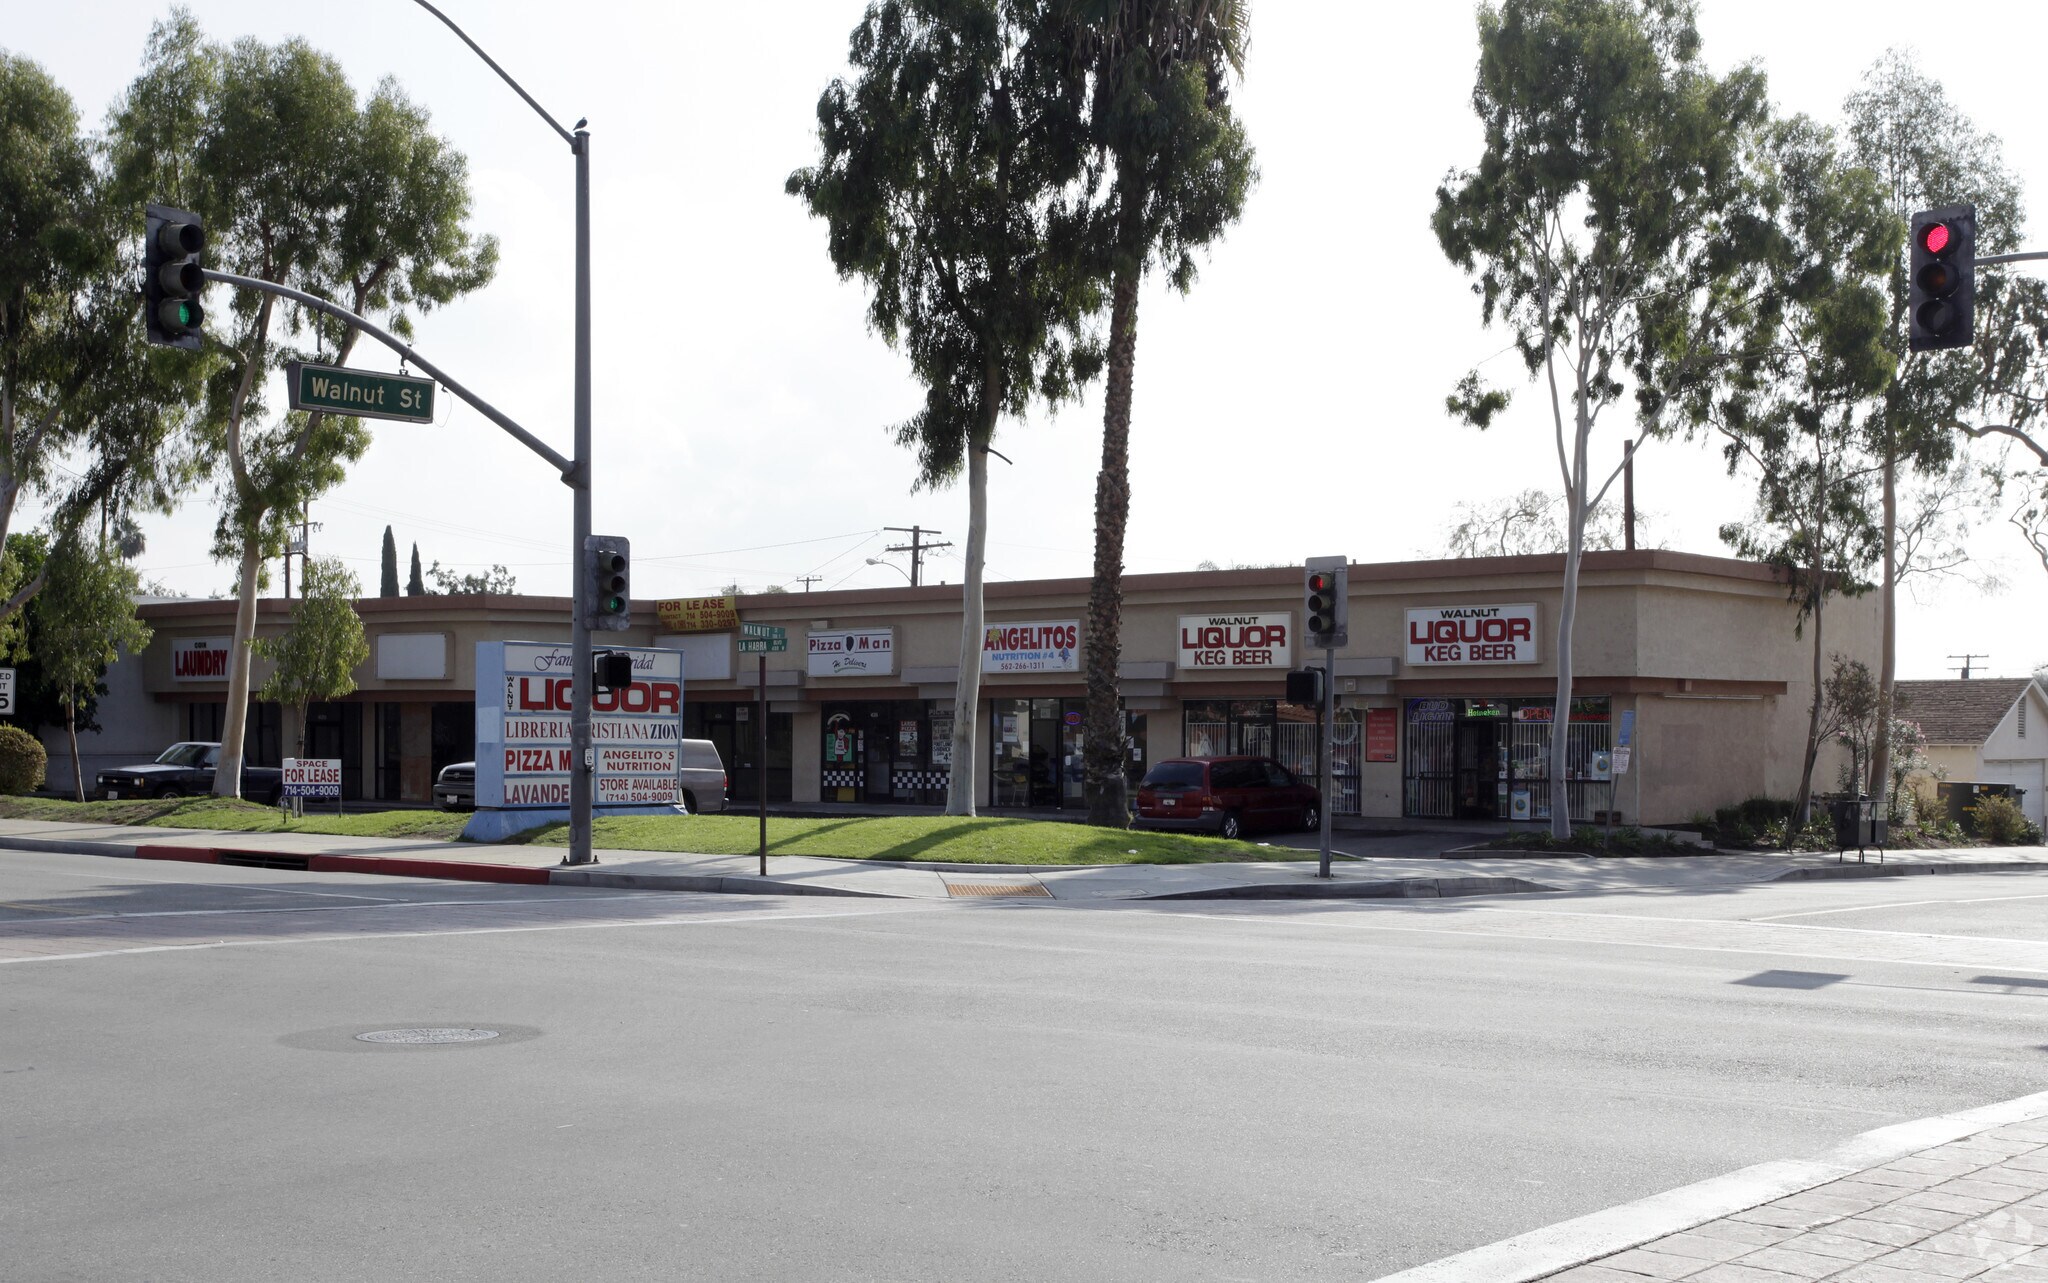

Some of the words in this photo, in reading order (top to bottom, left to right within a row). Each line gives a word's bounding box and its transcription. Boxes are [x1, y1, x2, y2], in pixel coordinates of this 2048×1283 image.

[311, 376, 385, 405] Walnut
[399, 388, 422, 410] St
[658, 601, 681, 612] FOR
[699, 609, 735, 619] 504-9009
[1440, 608, 1500, 619] WALNUT
[1208, 616, 1259, 626] WALNUT
[743, 625, 770, 638] WALNUT
[1182, 625, 1286, 649] LIQUOR
[1410, 618, 1531, 644] LIQUOR
[809, 639, 841, 651] Pizza
[858, 636, 890, 649] Man
[983, 625, 1077, 651] ANGELITOS
[738, 641, 746, 652] LA
[748, 641, 768, 652] HABRA
[1424, 643, 1462, 662] KEG
[1469, 643, 1516, 661] BEER
[992, 652, 1041, 661] NUTRITION
[1042, 651, 1054, 660] #4
[1194, 650, 1226, 665] KEG
[1232, 649, 1272, 665] BEER
[175, 650, 228, 676] LAUNDRY
[1000, 661, 1045, 670] 562-266-1311
[507, 676, 515, 711] WALNUT
[1418, 701, 1449, 711] BUD
[1412, 711, 1455, 722] LIGHT
[1467, 708, 1500, 718] Heineken
[1522, 707, 1552, 720] OPEN
[505, 721, 572, 739] LIBRERIA
[650, 723, 679, 740] ZION
[296, 760, 328, 768] SPACE
[505, 749, 554, 772] PIZZA
[606, 762, 672, 771] NUTRITION
[284, 769, 305, 783] FOR
[308, 769, 339, 783] LEASE
[284, 785, 340, 796] 714-504-9009
[599, 778, 629, 790] STORE
[631, 778, 678, 791] AVAILABLE
[504, 784, 571, 804] LAVANDE
[605, 793, 629, 802] (714)
[631, 791, 673, 802] 504-9009
